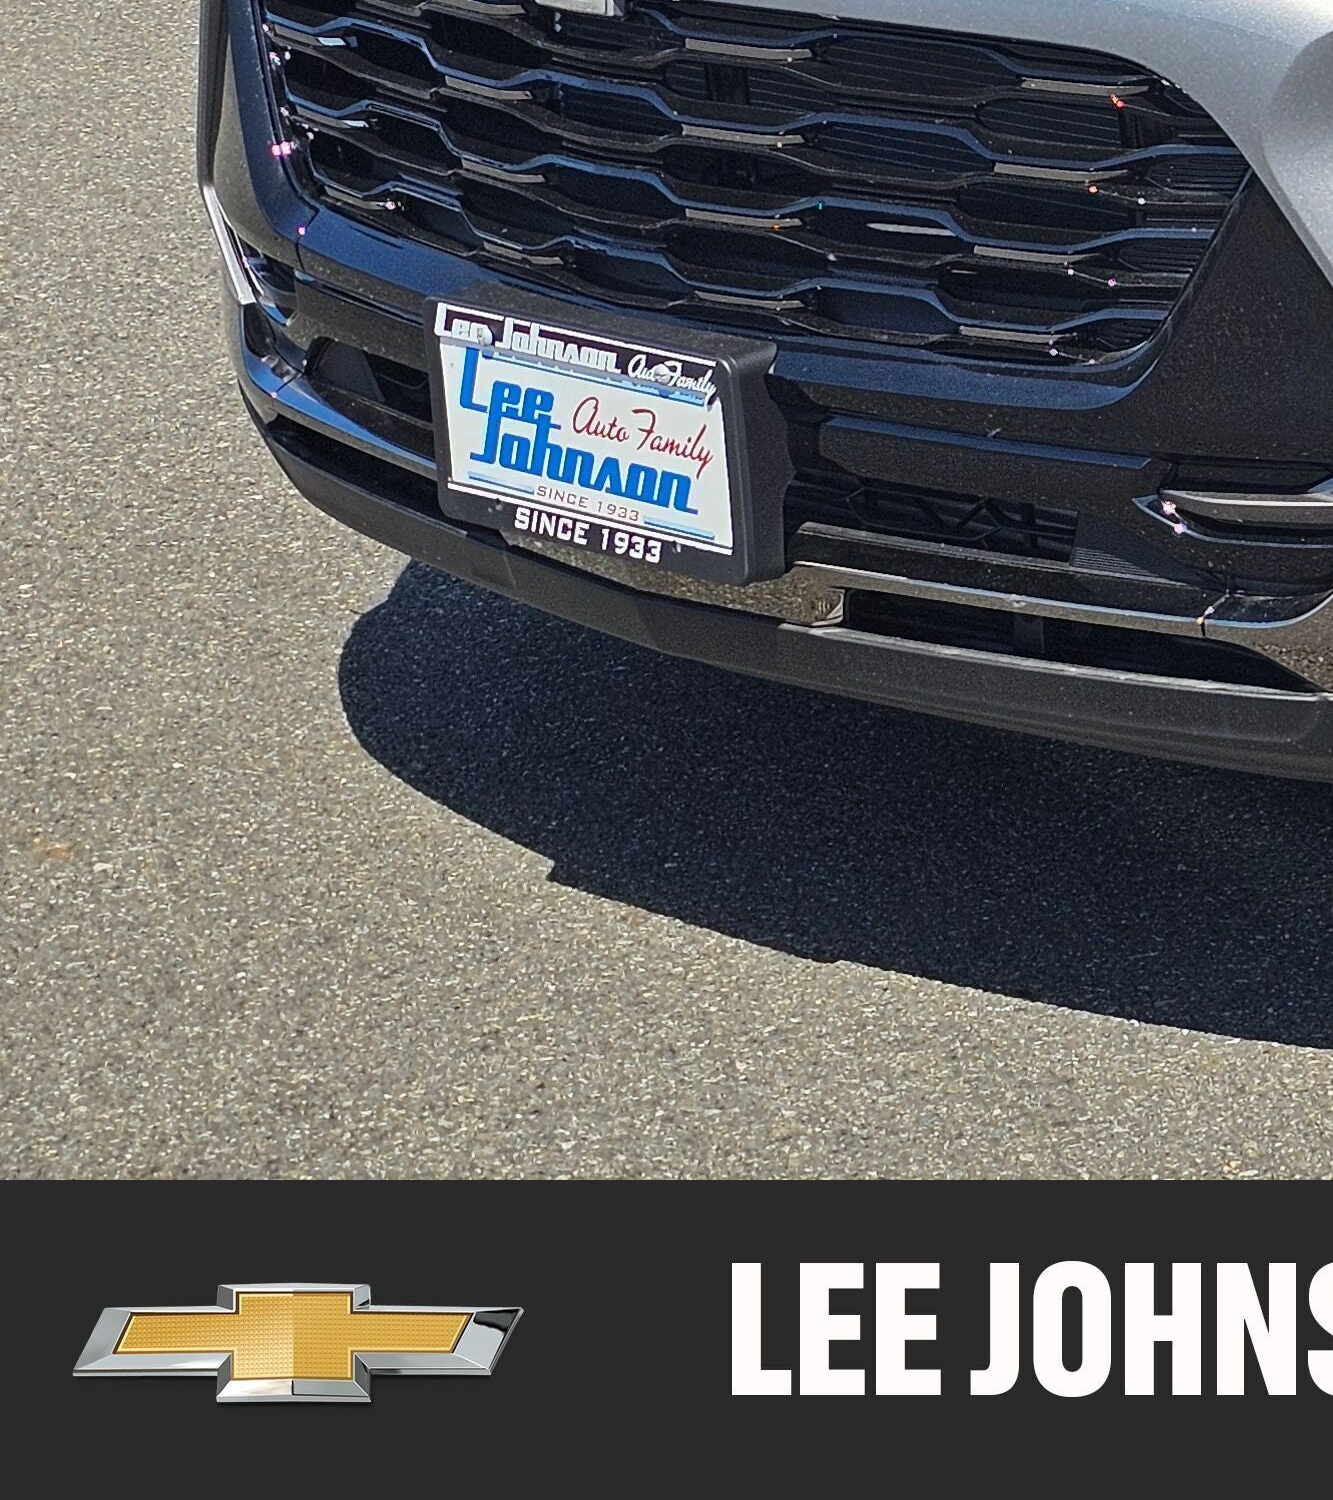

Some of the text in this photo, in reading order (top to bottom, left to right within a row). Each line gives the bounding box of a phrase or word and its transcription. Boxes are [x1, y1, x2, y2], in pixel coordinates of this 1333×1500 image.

[495, 317, 621, 376] Johnson
[459, 346, 562, 429] Lee
[469, 408, 699, 515] Johnson
[572, 396, 714, 480] Auto Family
[514, 508, 662, 564] SINCE 1933
[536, 485, 641, 522] SINCE 1933
